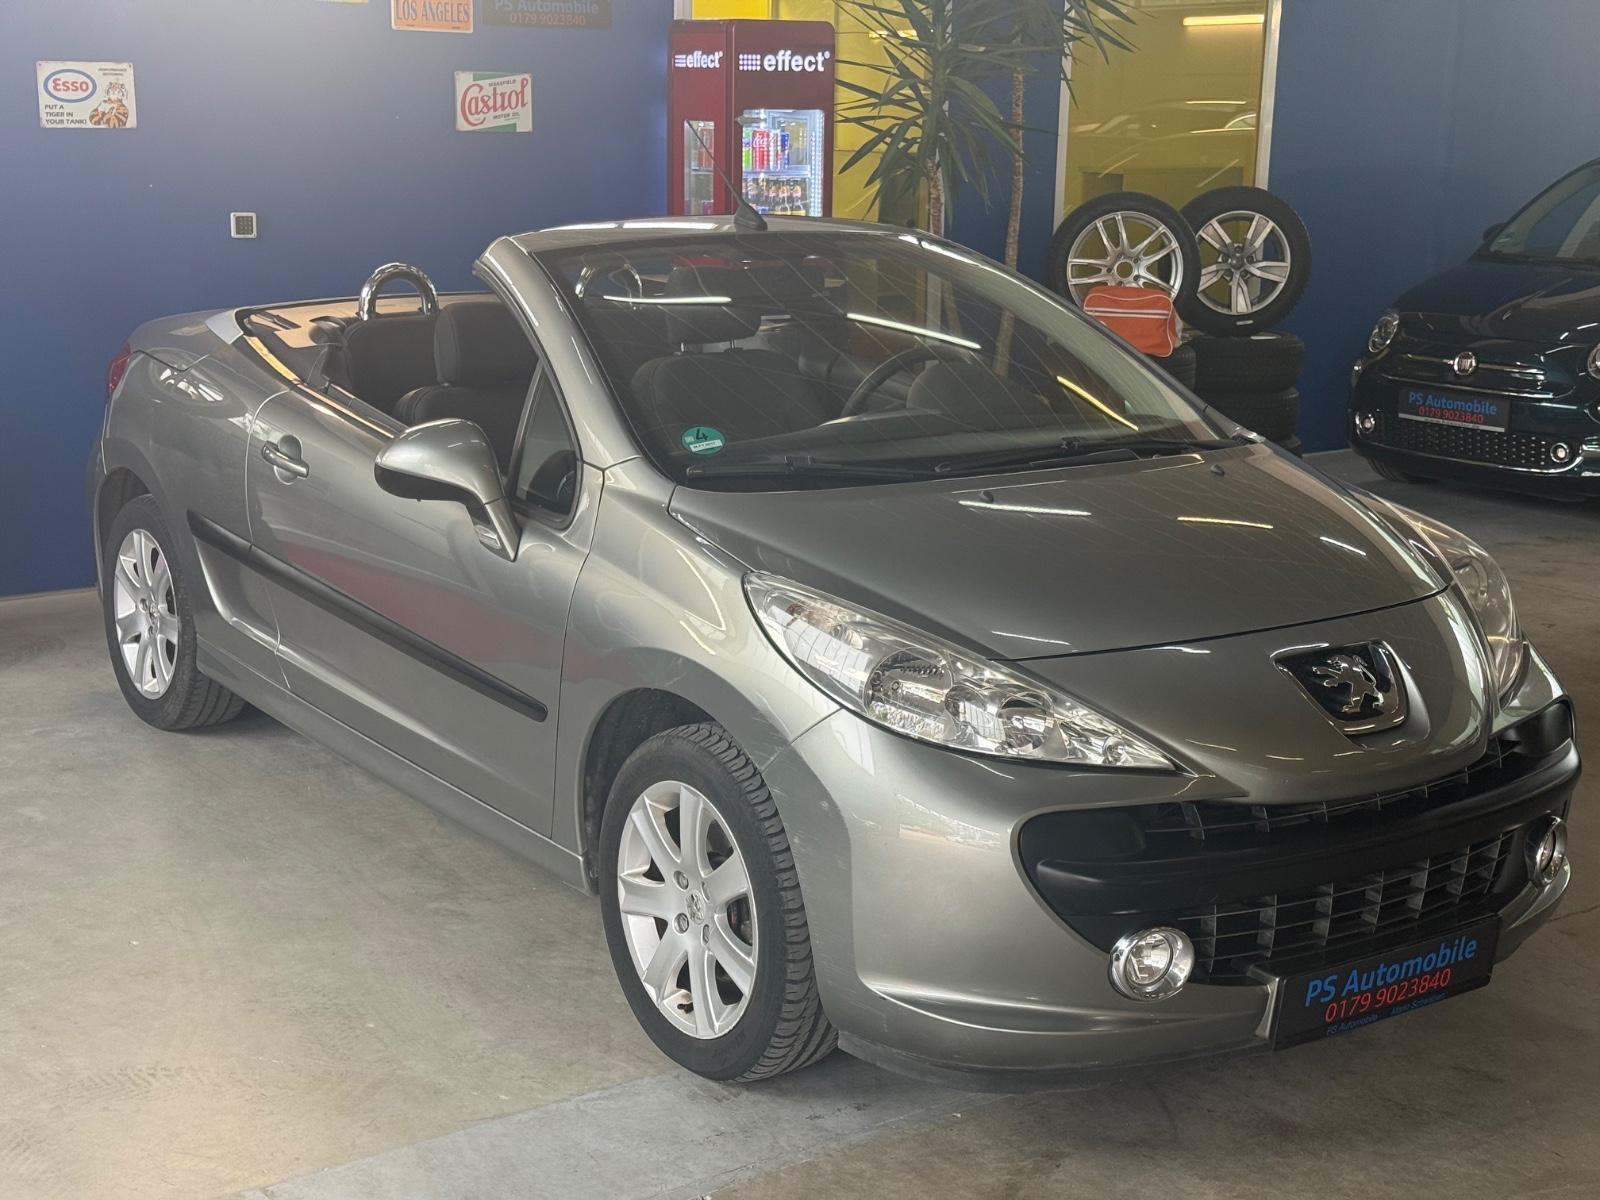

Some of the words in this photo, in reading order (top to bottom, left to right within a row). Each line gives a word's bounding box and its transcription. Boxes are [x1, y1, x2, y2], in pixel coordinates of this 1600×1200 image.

[396, 0, 417, 21] LOS
[421, 0, 470, 23] ANGELES
[495, 0, 513, 10] PS
[517, 0, 599, 14] Automobile
[510, 13, 537, 24] 0179
[540, 14, 586, 26] 9023840
[687, 50, 720, 68] effect
[763, 50, 825, 72] effect
[461, 77, 529, 127] Castrol
[1408, 392, 1424, 405] PS
[1425, 394, 1497, 415] Automobile
[1418, 406, 1440, 418] 0179
[1442, 409, 1484, 424] 9023840
[696, 428, 708, 440] 4
[1304, 974, 1338, 1007] PS
[1342, 935, 1478, 996] Automobile
[1325, 992, 1371, 1023] 0179
[1375, 968, 1451, 1009] 9023840
